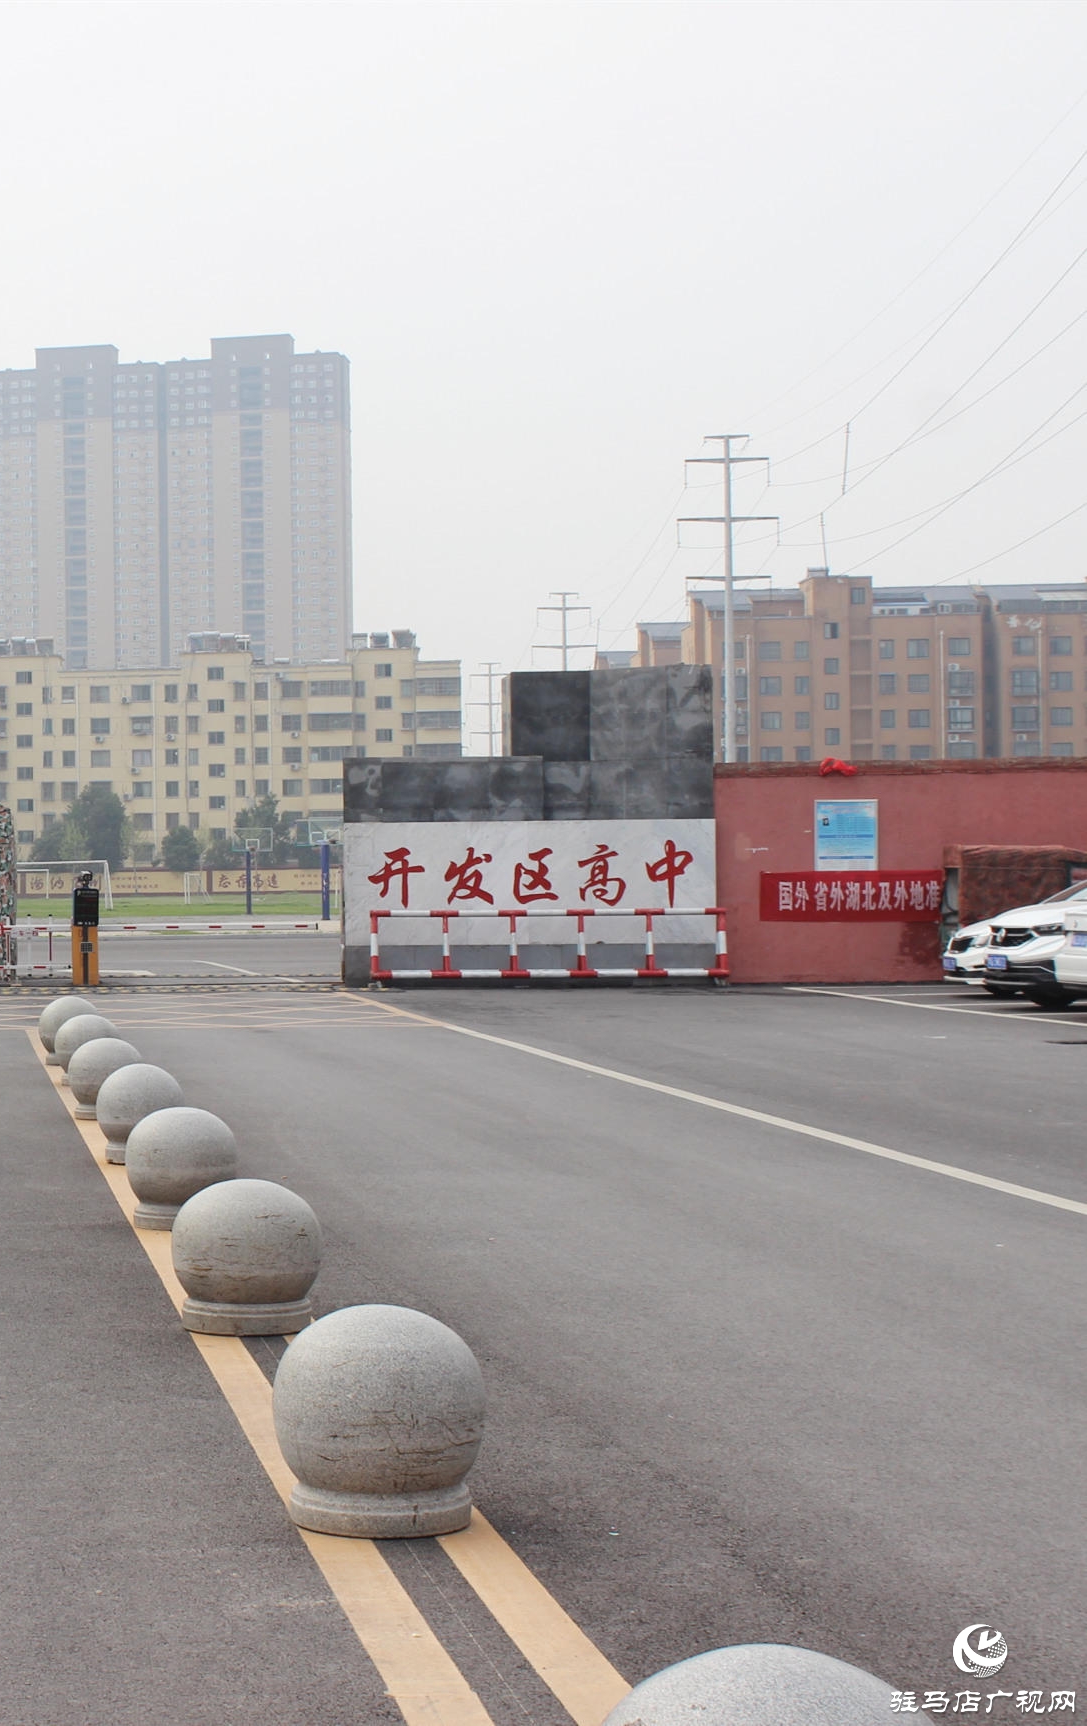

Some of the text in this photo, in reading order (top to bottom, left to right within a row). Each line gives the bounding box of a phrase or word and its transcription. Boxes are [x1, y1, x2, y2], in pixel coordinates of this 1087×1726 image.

[368, 840, 693, 909] 开发区高中
